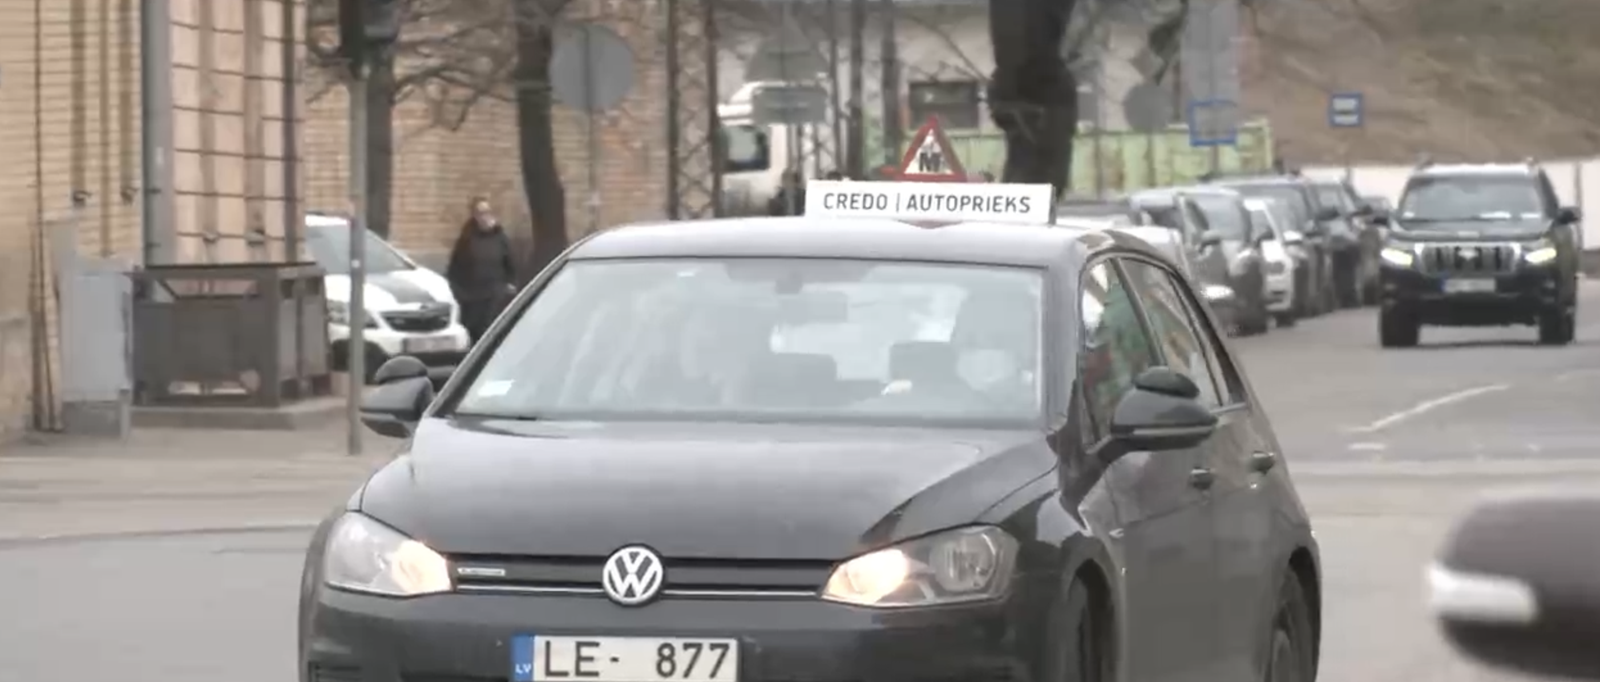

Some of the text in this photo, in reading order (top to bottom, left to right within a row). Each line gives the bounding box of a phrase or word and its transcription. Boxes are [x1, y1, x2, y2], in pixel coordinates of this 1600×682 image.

[823, 192, 888, 211] CREDO
[906, 193, 1031, 213] AUTOPRIEKS
[515, 664, 532, 674] LV
[655, 642, 731, 679] 877
